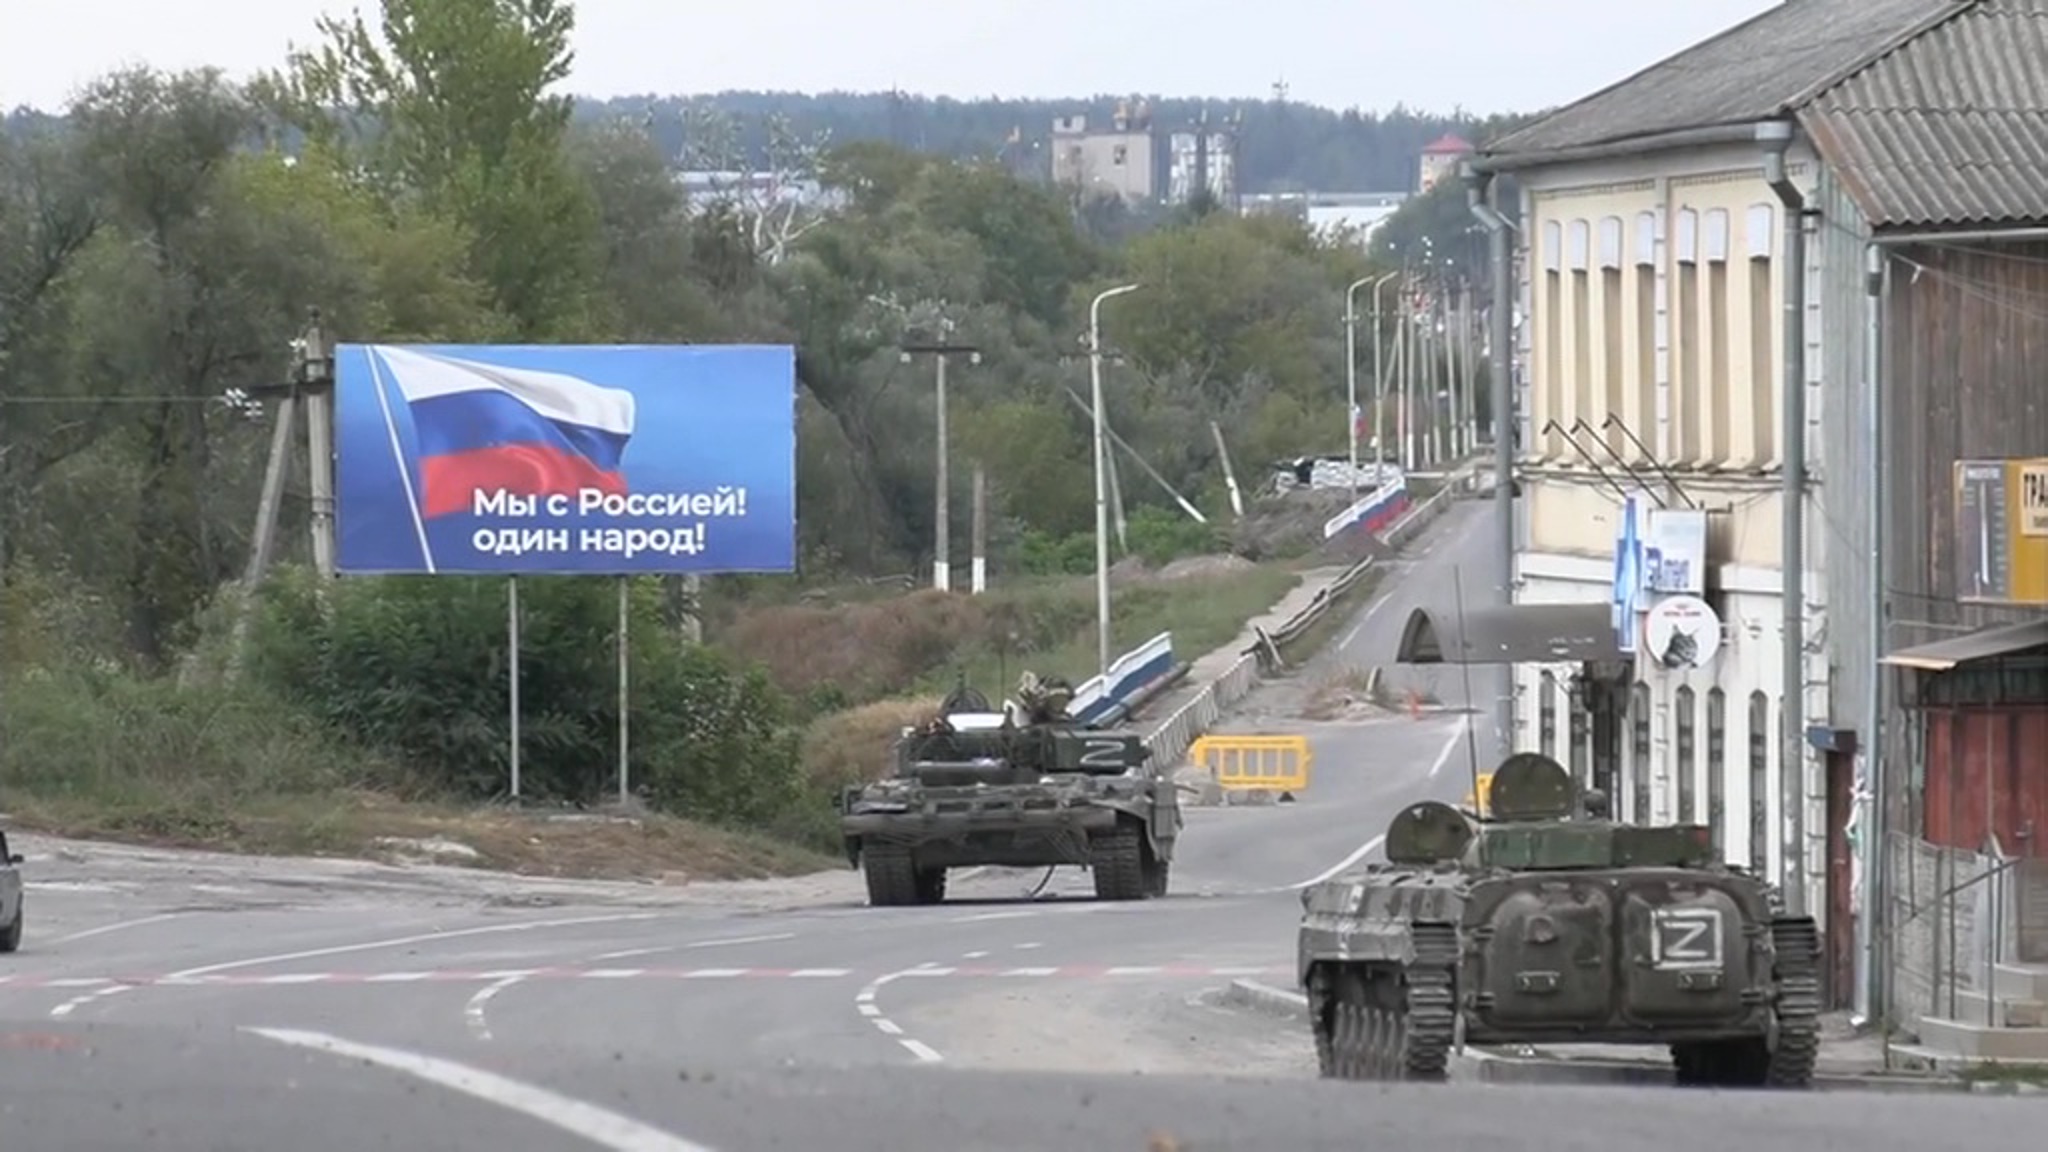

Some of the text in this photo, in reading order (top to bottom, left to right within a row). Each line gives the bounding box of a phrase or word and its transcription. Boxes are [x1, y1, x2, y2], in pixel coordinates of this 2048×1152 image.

[473, 486, 747, 516] Мы с Россией!
[473, 522, 706, 558] один народ!
[1663, 920, 1708, 958] Z
